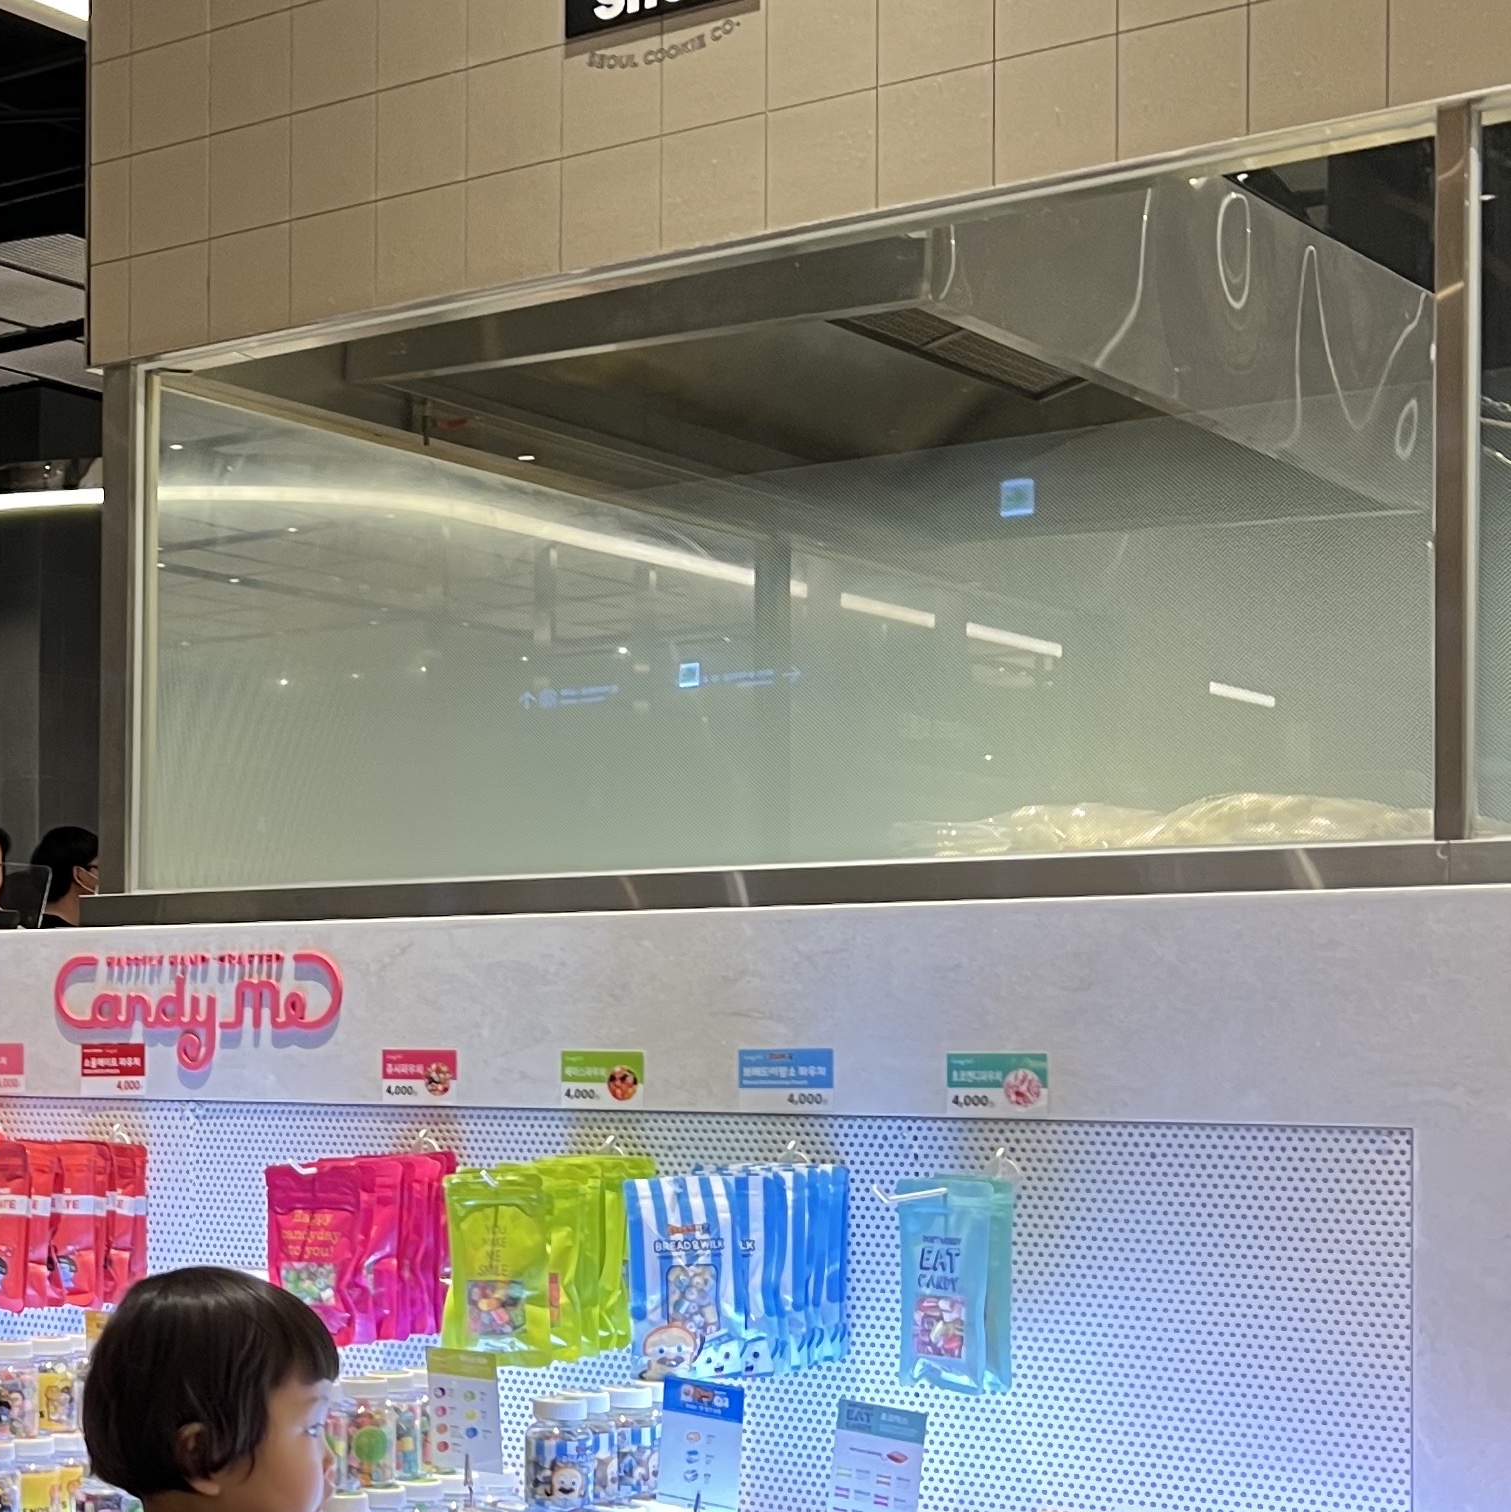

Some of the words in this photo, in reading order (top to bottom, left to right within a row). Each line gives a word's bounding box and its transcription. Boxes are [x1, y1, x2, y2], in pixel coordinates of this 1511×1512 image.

[54, 954, 218, 1072] Candy
[218, 951, 344, 1031] Me
[919, 1246, 961, 1274] EAT
